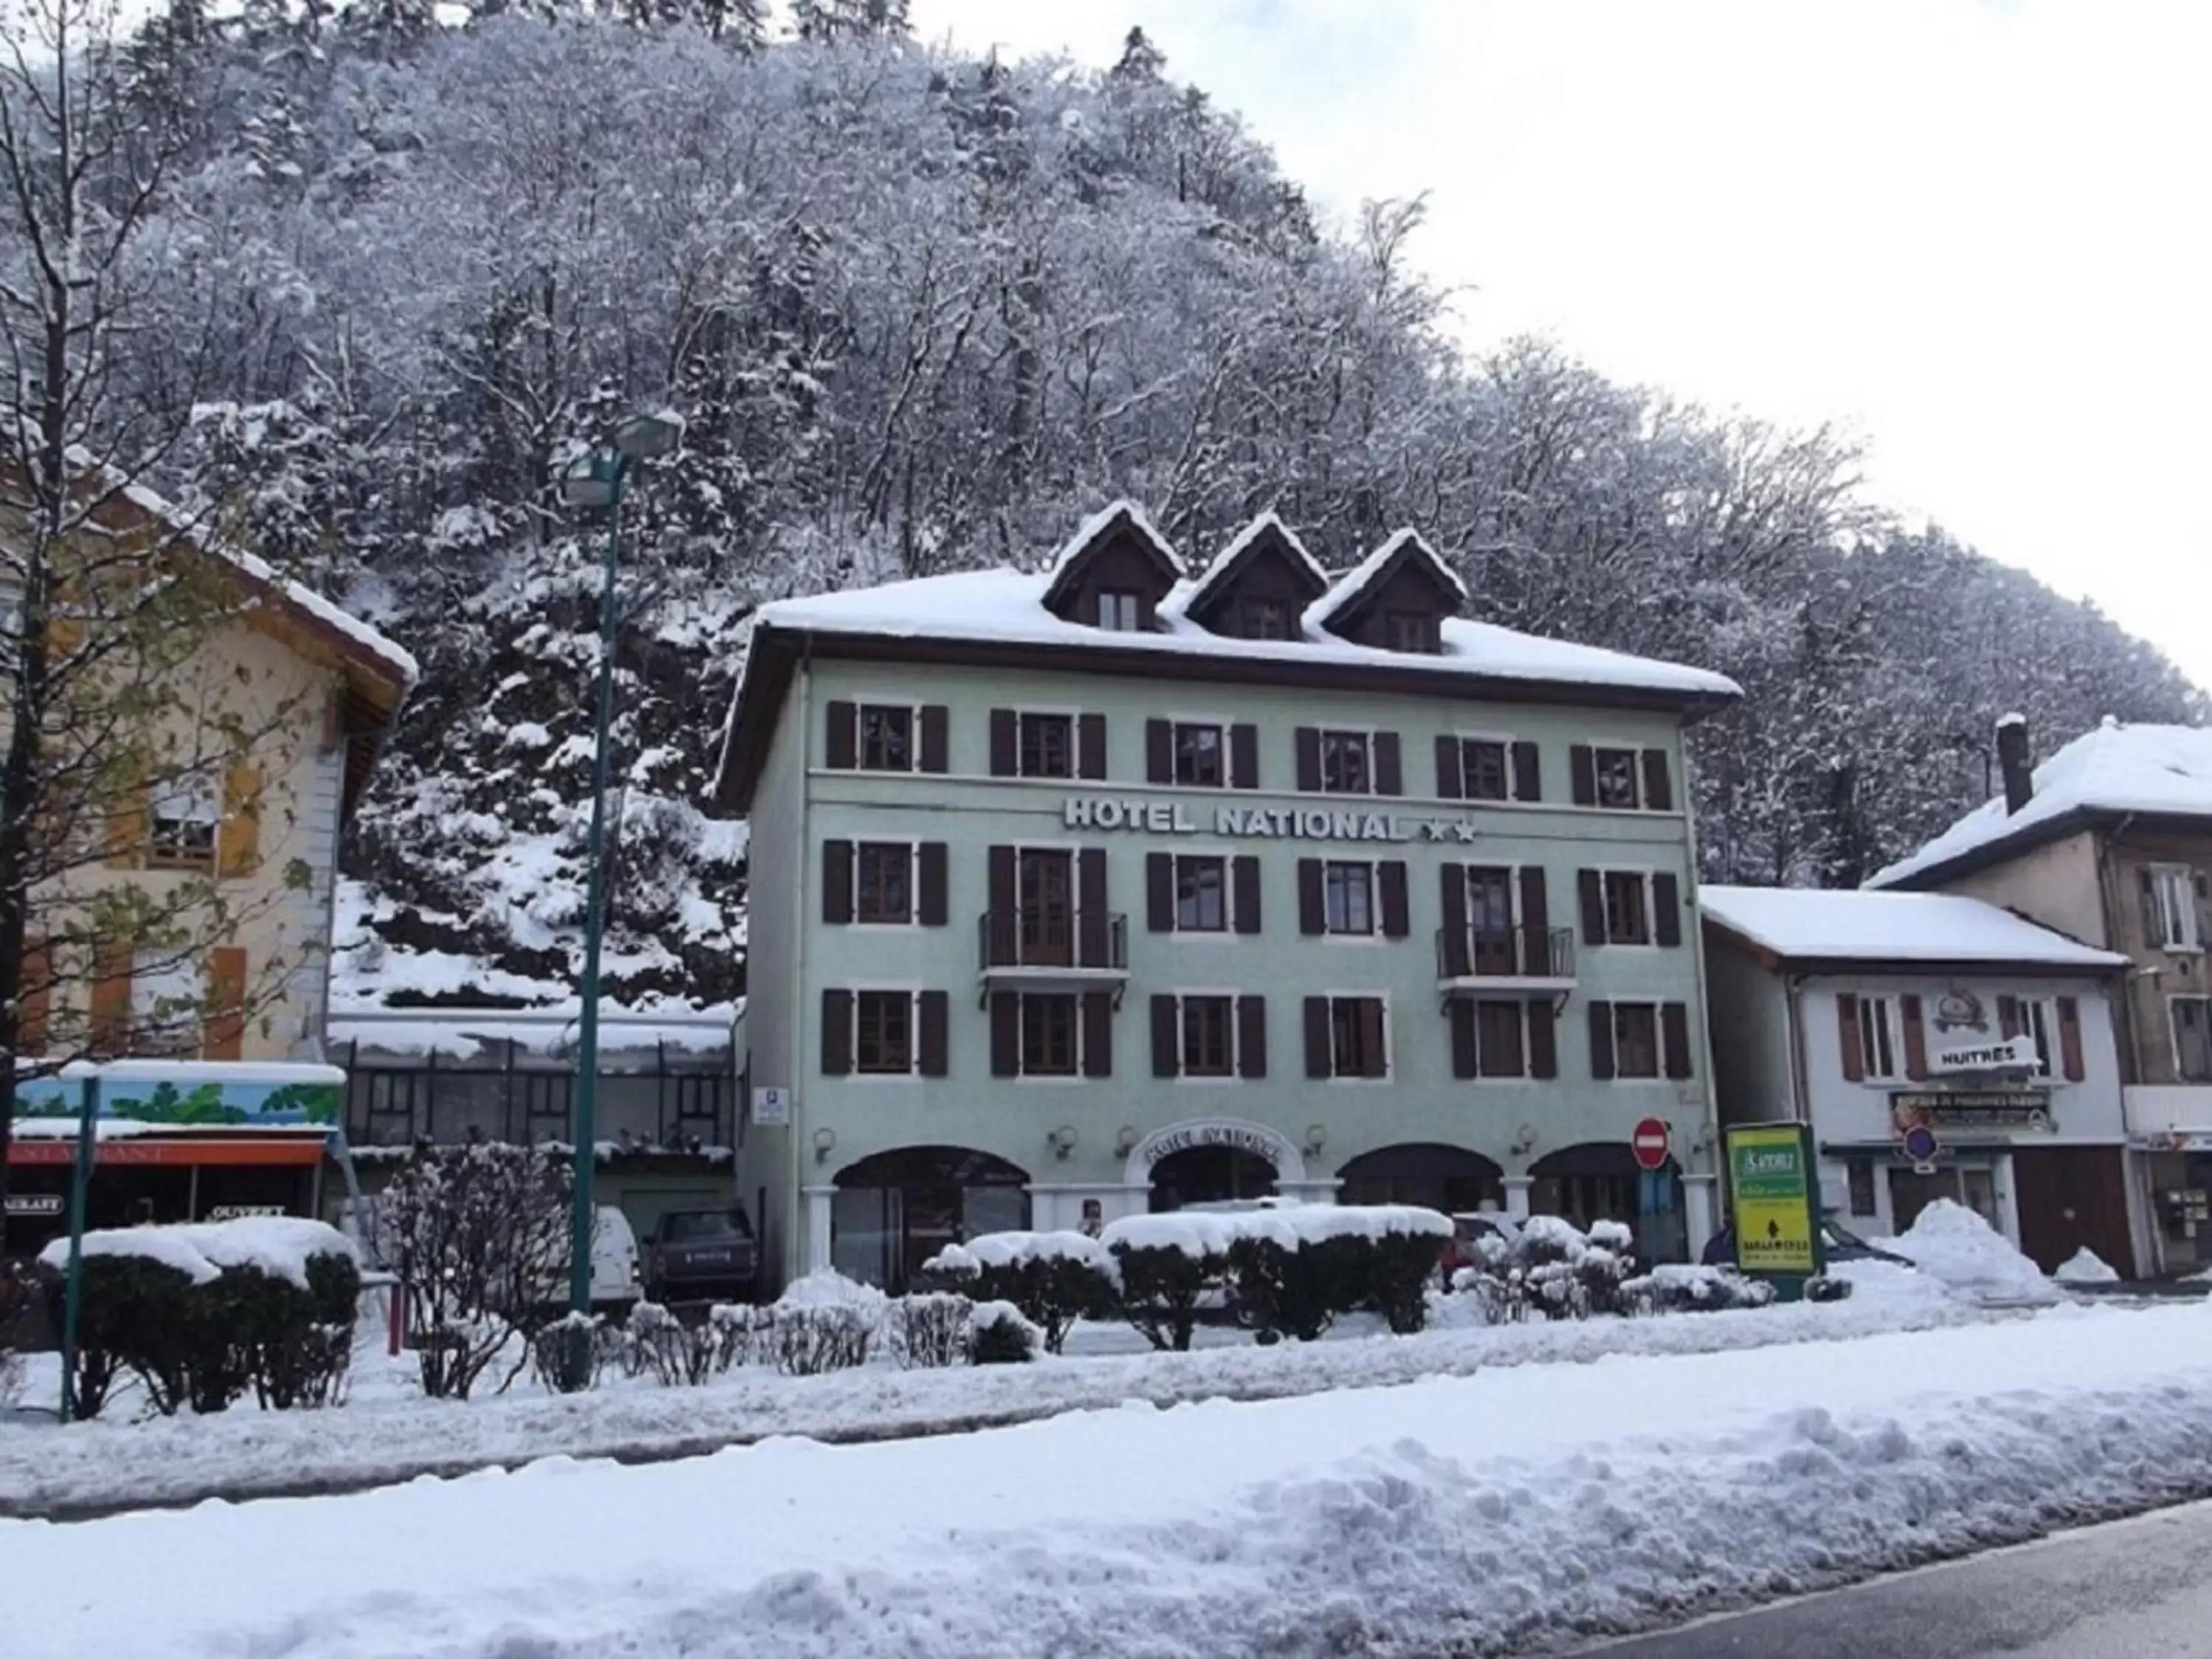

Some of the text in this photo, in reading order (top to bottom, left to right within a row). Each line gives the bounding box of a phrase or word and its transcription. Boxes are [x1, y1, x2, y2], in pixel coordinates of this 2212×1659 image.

[1064, 796, 1410, 842] HOTEL NATIONAL
[1942, 1046, 2016, 1065] HUITRES
